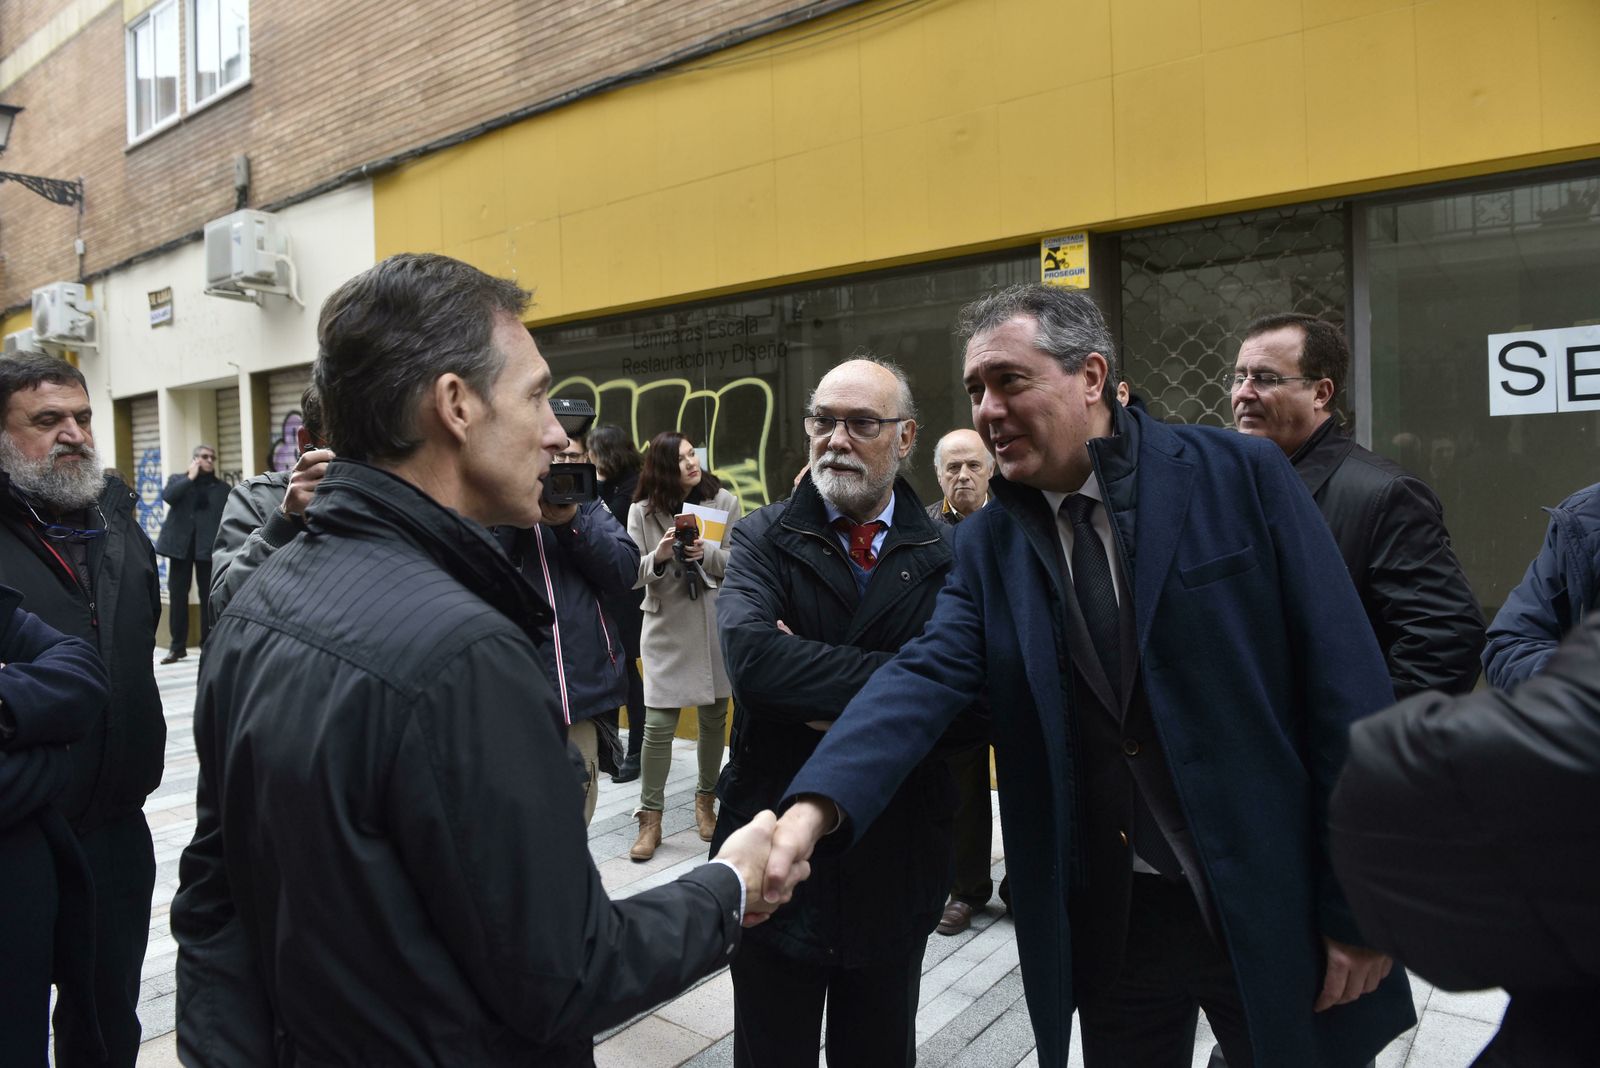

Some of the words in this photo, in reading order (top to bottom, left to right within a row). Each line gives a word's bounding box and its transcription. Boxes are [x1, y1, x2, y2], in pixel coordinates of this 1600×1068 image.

[1044, 268, 1086, 279] PROSEGUR
[707, 319, 758, 339] Escala
[718, 350, 727, 370] y
[732, 340, 788, 363] Diseño
[1498, 340, 1600, 402] SE
